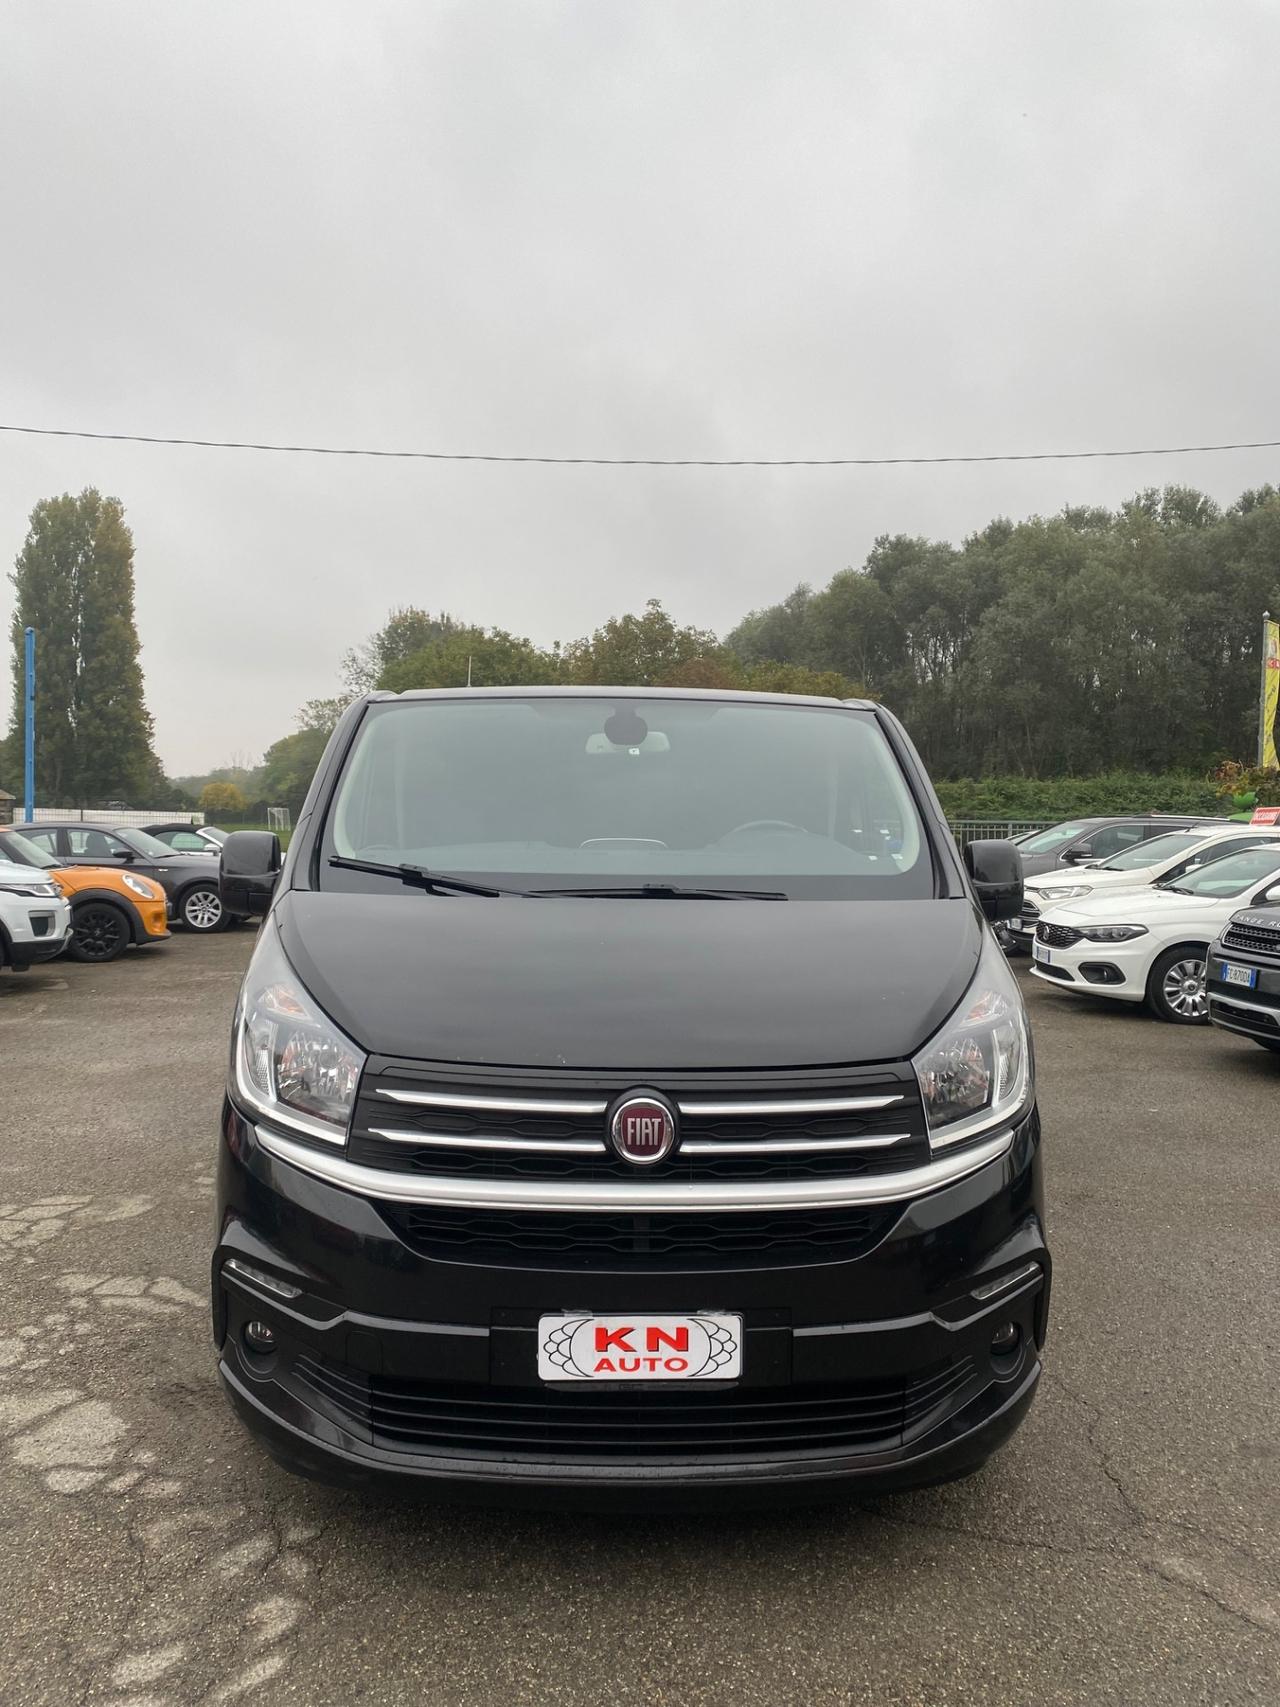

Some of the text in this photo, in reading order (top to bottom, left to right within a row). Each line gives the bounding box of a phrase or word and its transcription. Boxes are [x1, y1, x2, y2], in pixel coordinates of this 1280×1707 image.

[627, 1117, 661, 1146] FIAT
[595, 1327, 689, 1352] KN
[594, 1358, 689, 1372] AUTO
